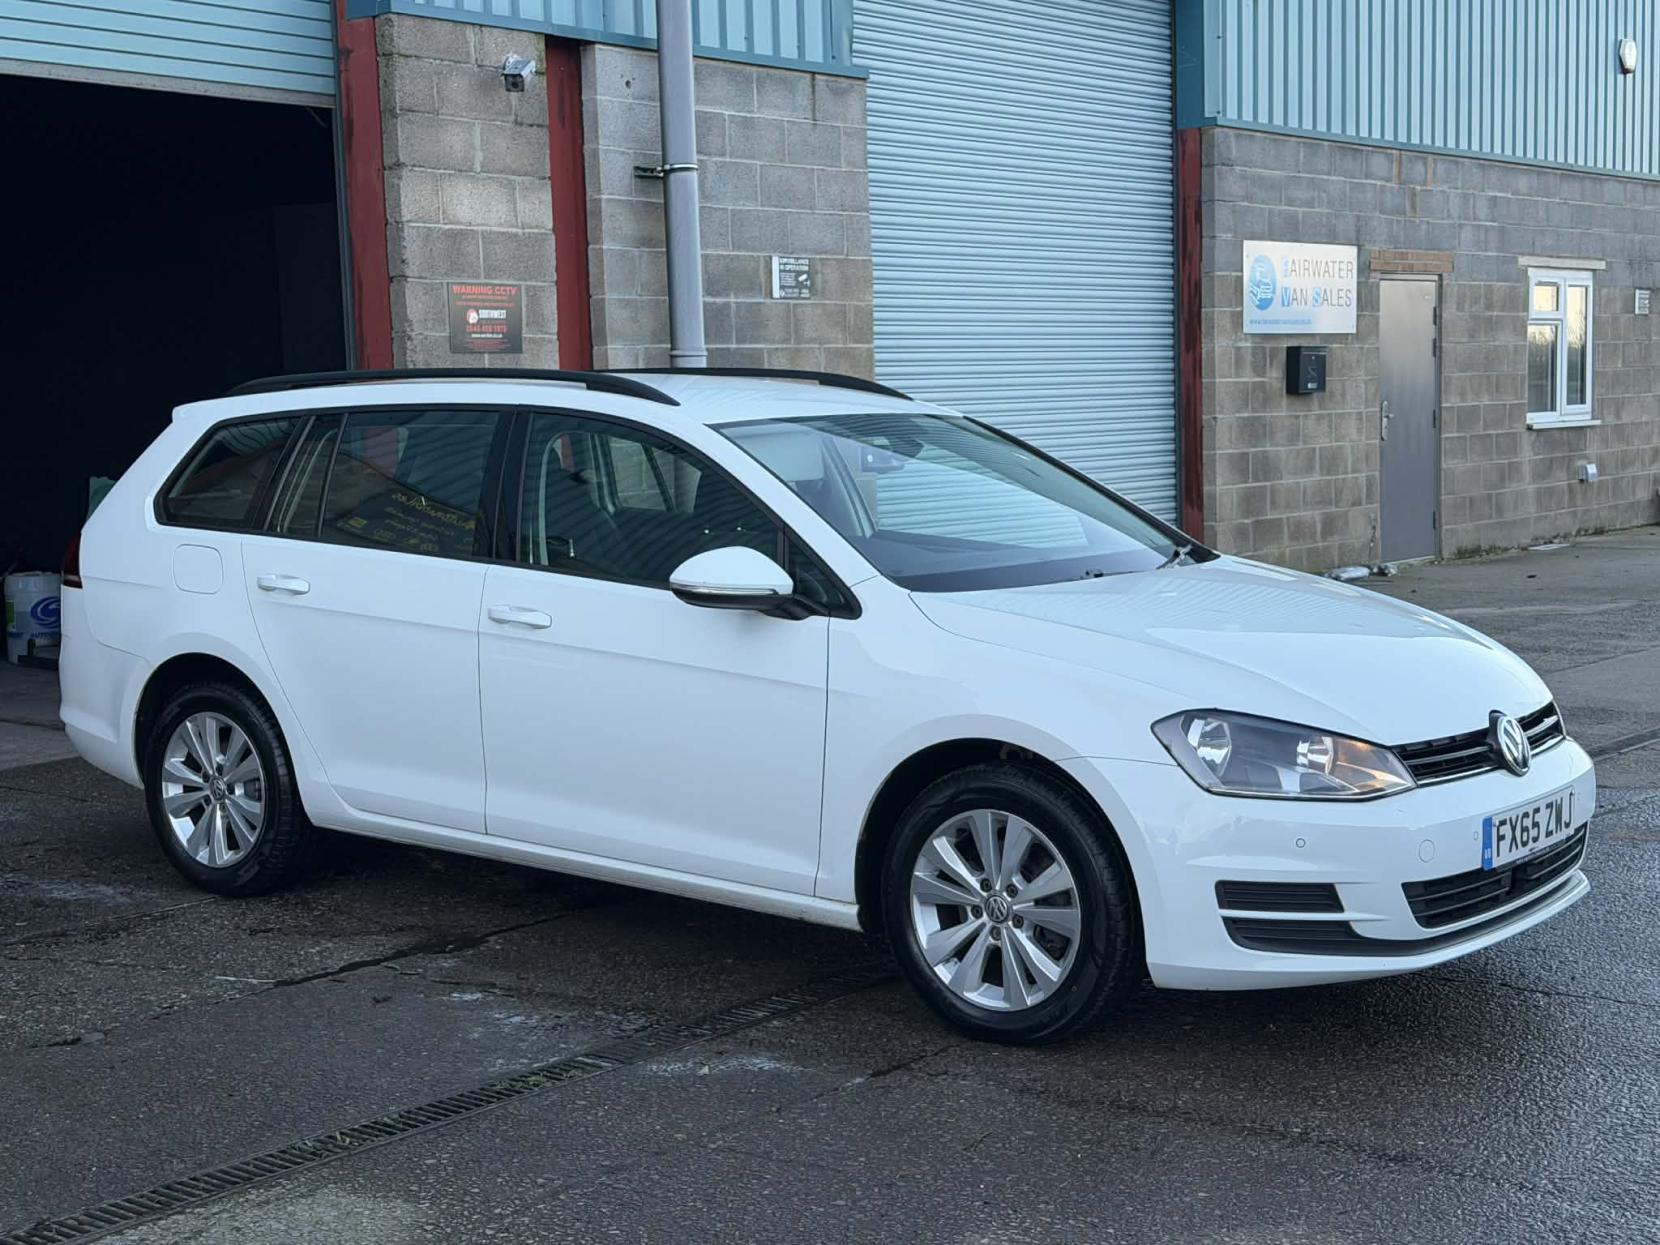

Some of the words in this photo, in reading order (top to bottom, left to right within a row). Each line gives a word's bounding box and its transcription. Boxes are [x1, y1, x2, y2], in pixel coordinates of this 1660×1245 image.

[453, 284, 493, 295] WARNING
[495, 286, 518, 296] CCTV
[1281, 287, 1309, 308] VAN
[1312, 287, 1352, 308] SALES
[1496, 806, 1541, 858] FX65
[1545, 790, 1574, 839] ZWJ
